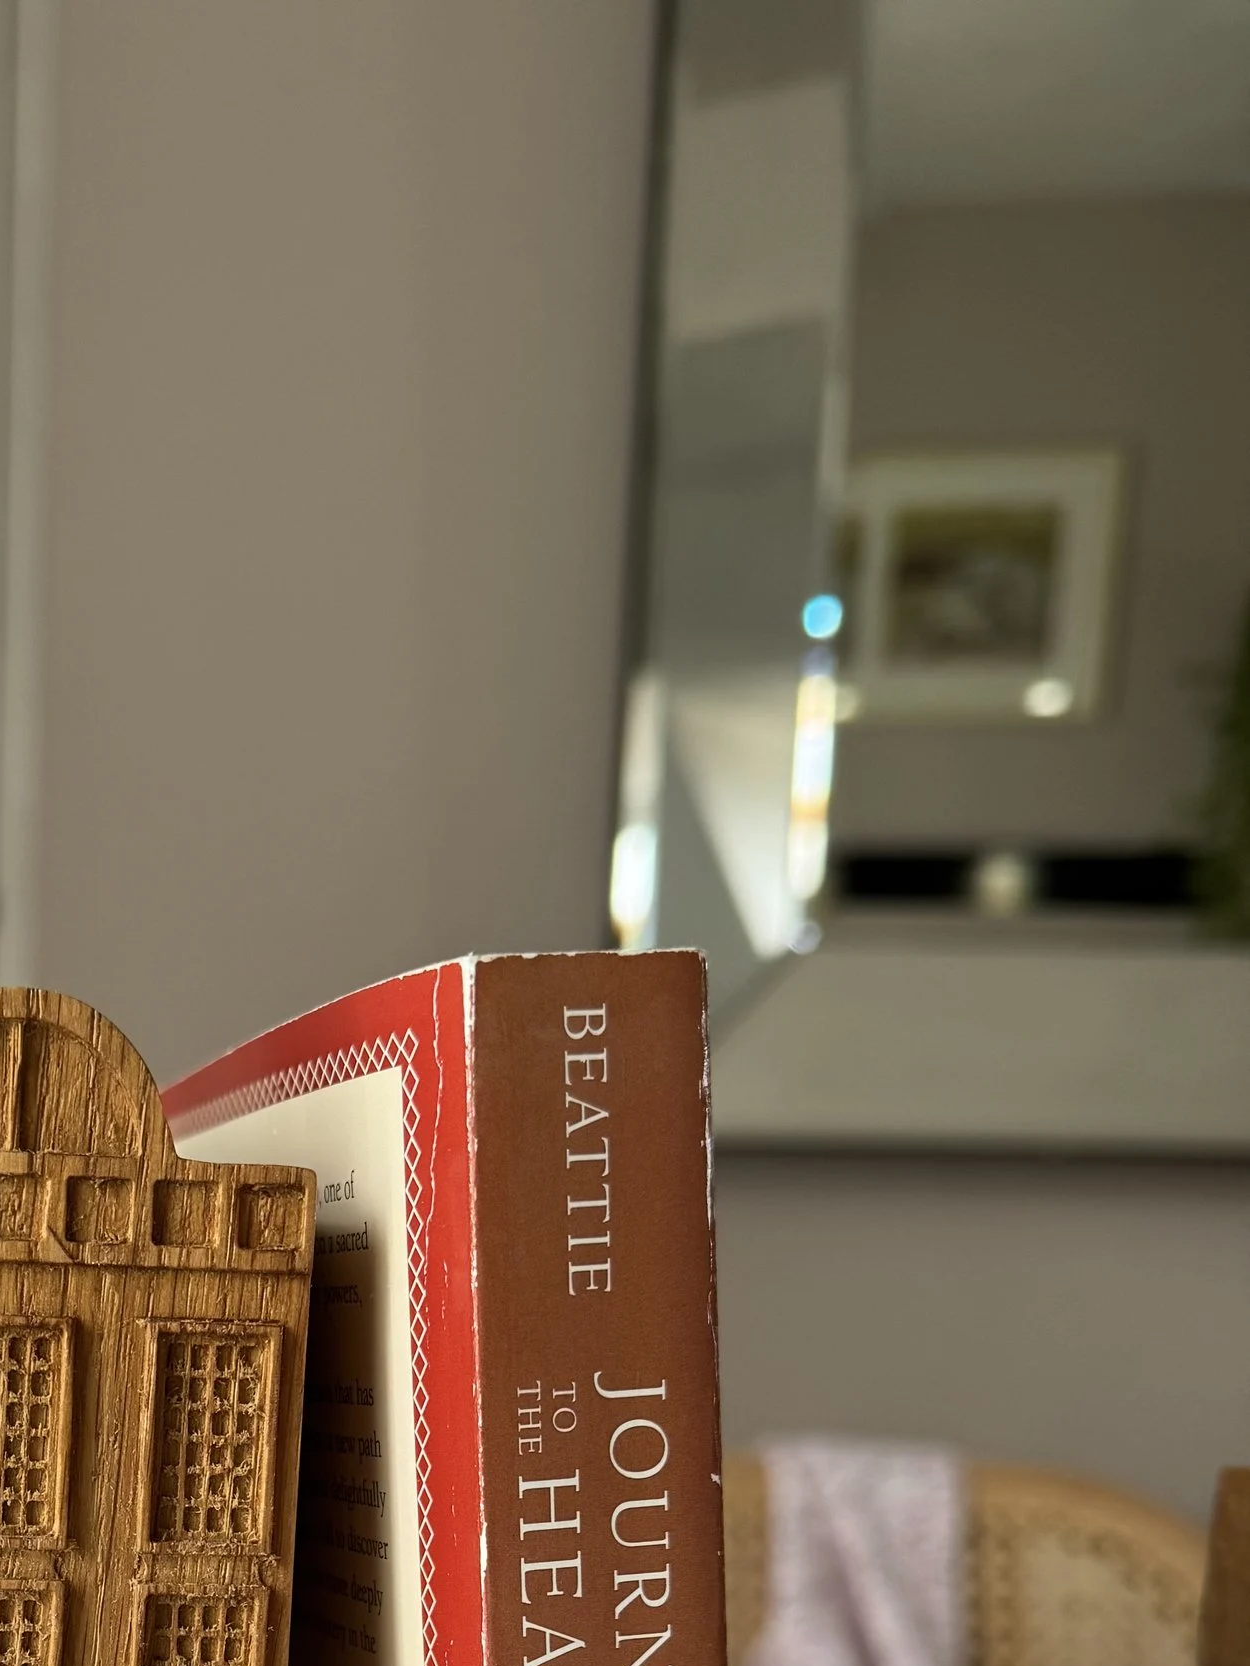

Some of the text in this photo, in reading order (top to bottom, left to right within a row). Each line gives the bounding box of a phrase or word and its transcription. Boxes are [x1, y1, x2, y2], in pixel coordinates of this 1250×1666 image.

[563, 1002, 612, 1296] BEATTIE
[323, 1170, 355, 1204] one of
[336, 1221, 369, 1254] sacred
[355, 1378, 374, 1407] has
[552, 1381, 578, 1434] TO
[516, 1379, 543, 1456] THE
[357, 1430, 383, 1465] path
[347, 1524, 389, 1560] discover
[351, 1573, 384, 1616] deeply
